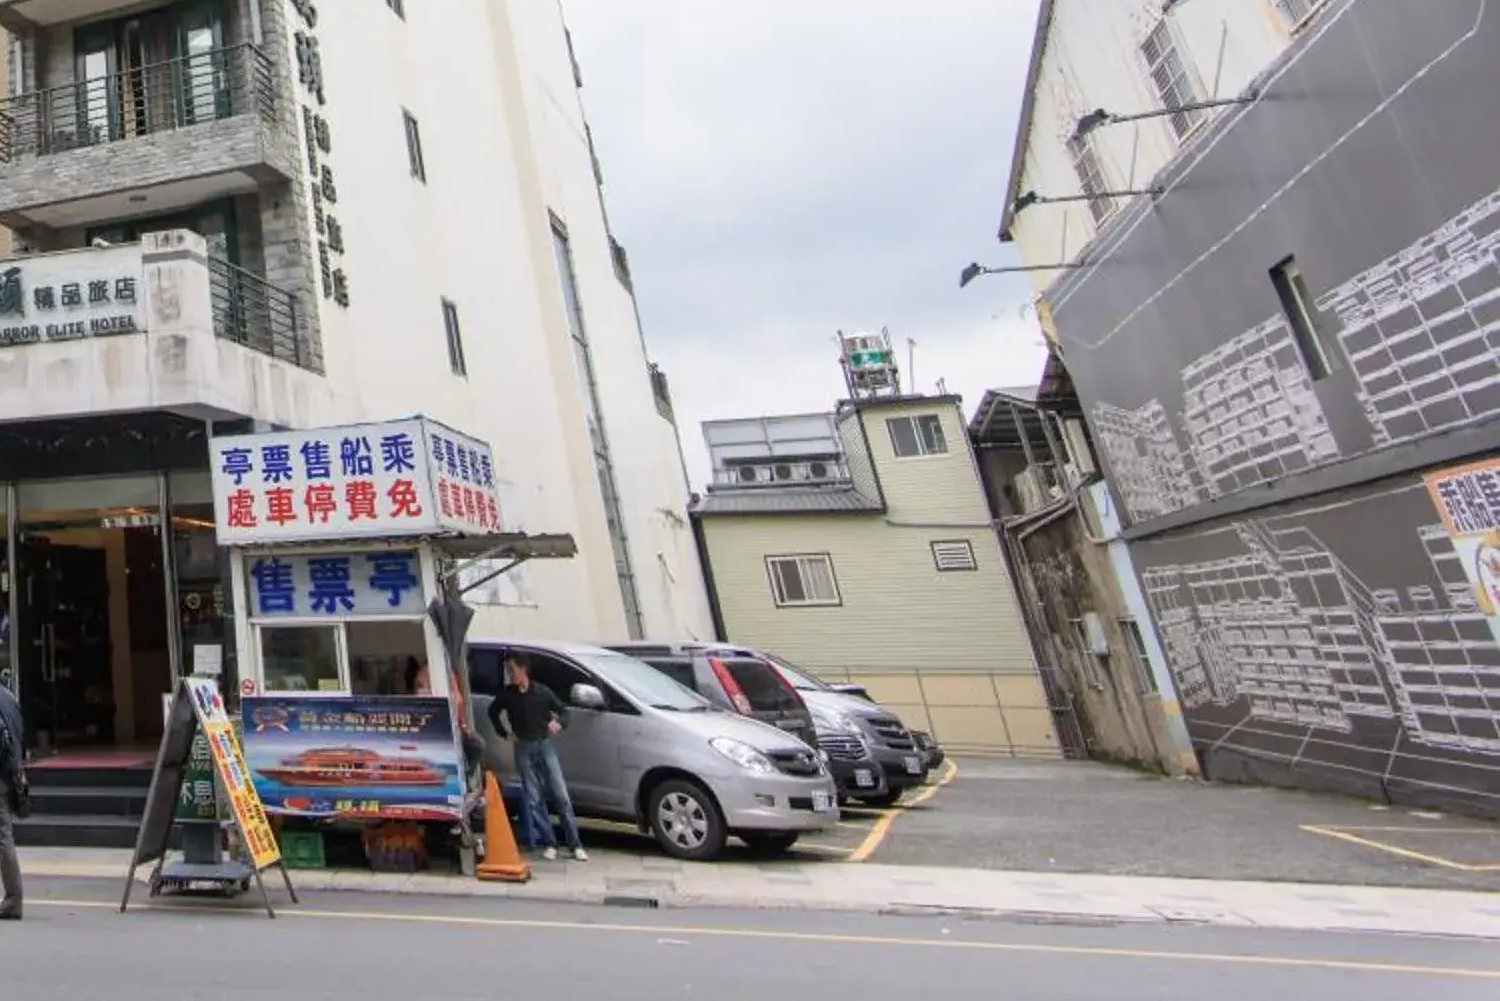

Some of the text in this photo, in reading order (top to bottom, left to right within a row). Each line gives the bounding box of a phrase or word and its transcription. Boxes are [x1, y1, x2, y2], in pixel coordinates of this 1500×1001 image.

[34, 277, 138, 312] 精品旅店
[46, 321, 85, 337] ELITE
[90, 314, 136, 331] HOTEL
[251, 552, 417, 616] 售票亭
